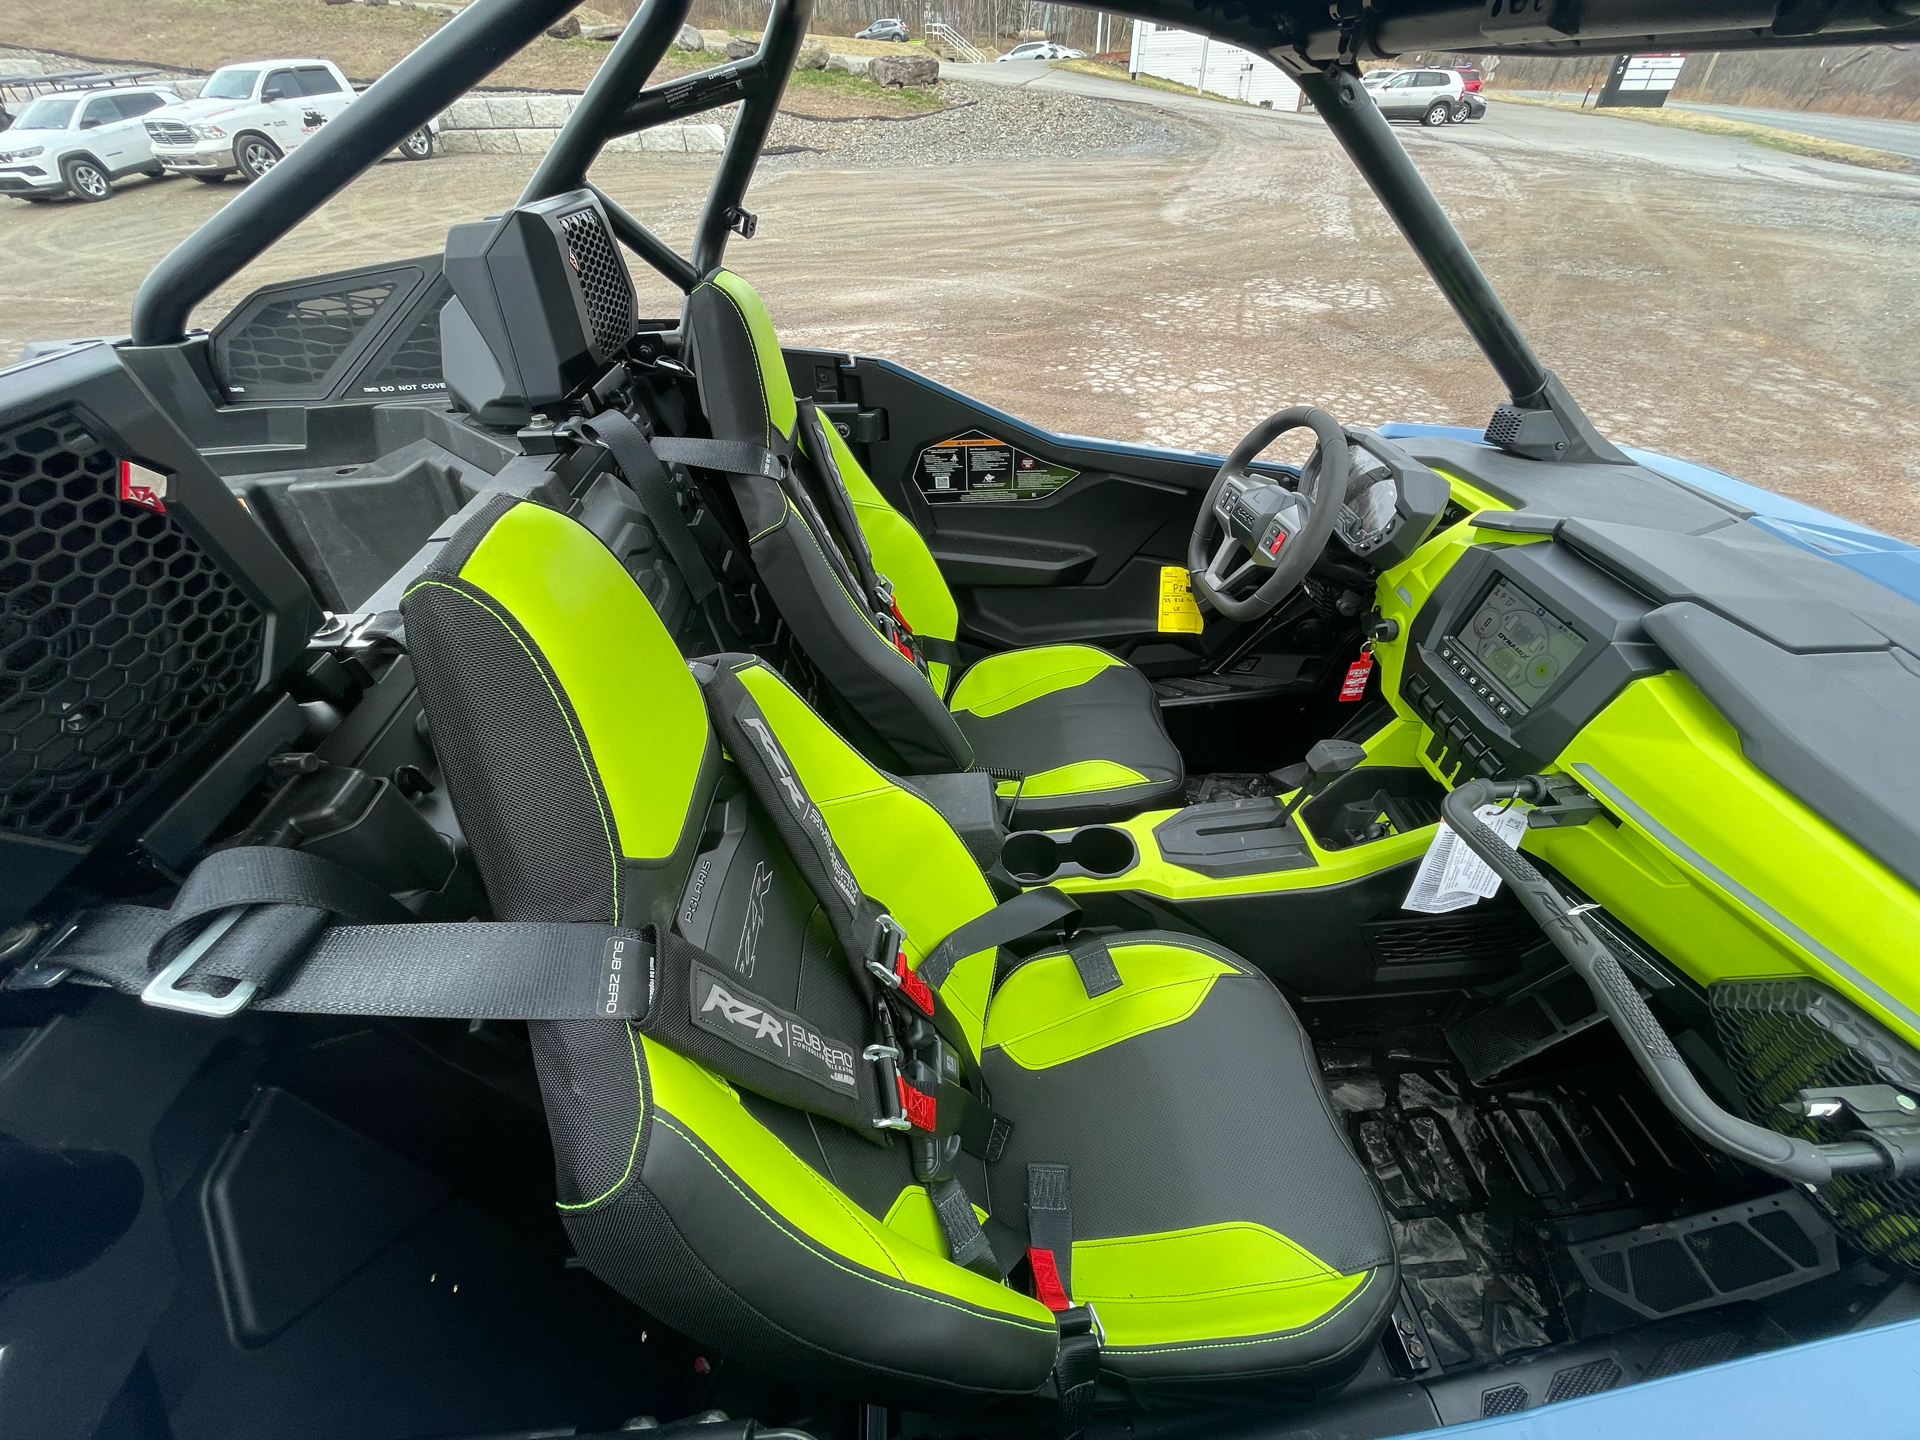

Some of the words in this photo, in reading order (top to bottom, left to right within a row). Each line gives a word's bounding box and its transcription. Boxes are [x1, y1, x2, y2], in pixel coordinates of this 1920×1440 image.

[1616, 66, 1624, 74] 3
[1621, 55, 1629, 64] 7
[399, 384, 418, 392] NOT
[422, 382, 446, 390] COVE
[1497, 632, 1530, 660] DYNAMIX
[744, 718, 805, 810] RZR
[684, 860, 711, 924] POLARIS
[1531, 890, 1589, 946] RZR
[611, 940, 624, 970] SUB
[606, 973, 620, 1014] ZERO
[701, 983, 784, 1047] RZR
[792, 1024, 824, 1052] SUB
